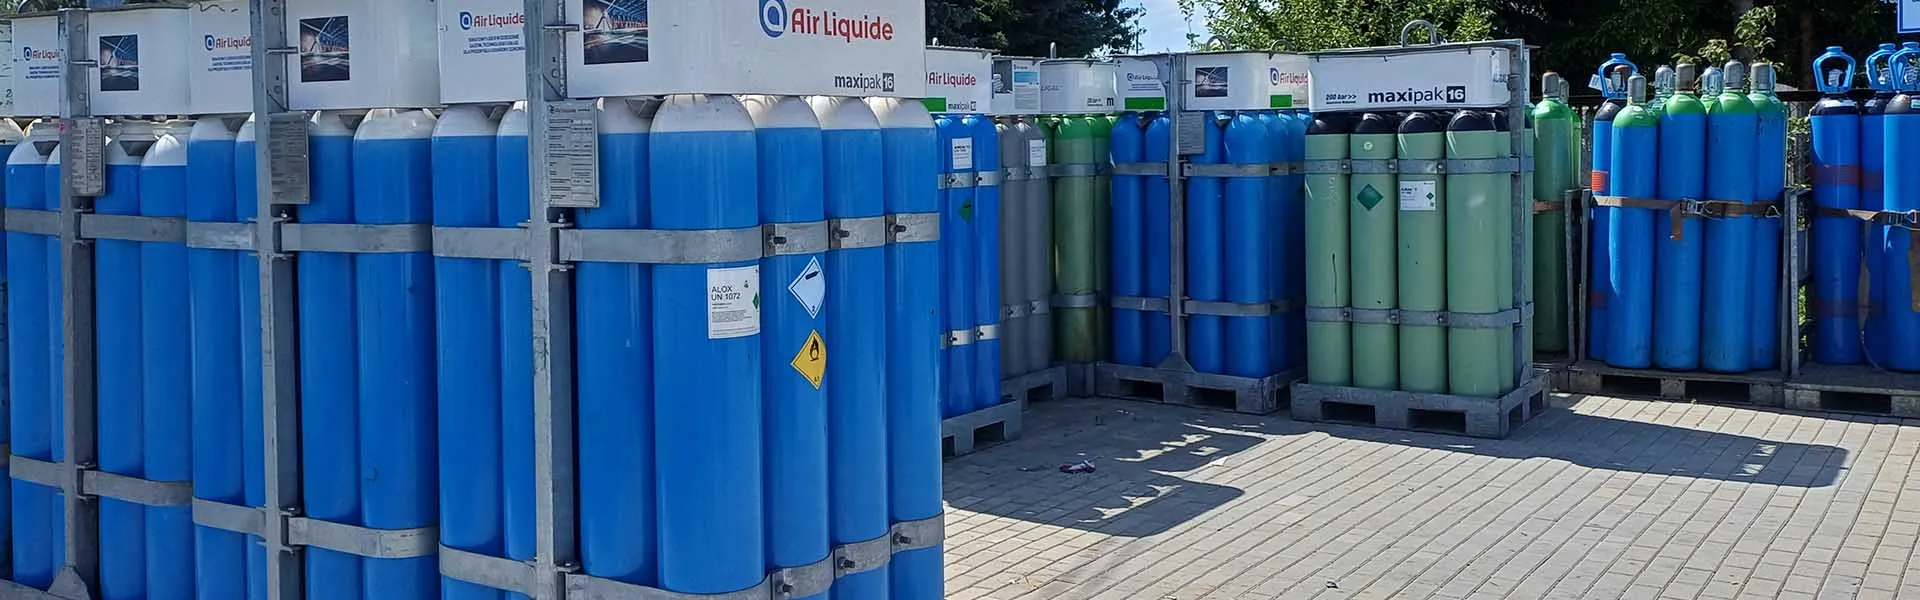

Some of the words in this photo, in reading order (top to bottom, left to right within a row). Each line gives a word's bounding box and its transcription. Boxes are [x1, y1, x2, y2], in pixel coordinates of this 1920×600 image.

[474, 16, 488, 28] Air
[489, 13, 525, 29] Liquide
[791, 8, 820, 35] Air
[823, 10, 894, 43] Liquide
[834, 73, 882, 93] maxipak
[883, 75, 894, 91] 16
[929, 72, 942, 86] Air
[943, 73, 976, 88] Liquide
[1368, 86, 1444, 104] maxipak
[1447, 87, 1465, 101] 16
[711, 285, 733, 294] ALOX
[711, 293, 723, 301] UN
[725, 292, 741, 301] 1072
